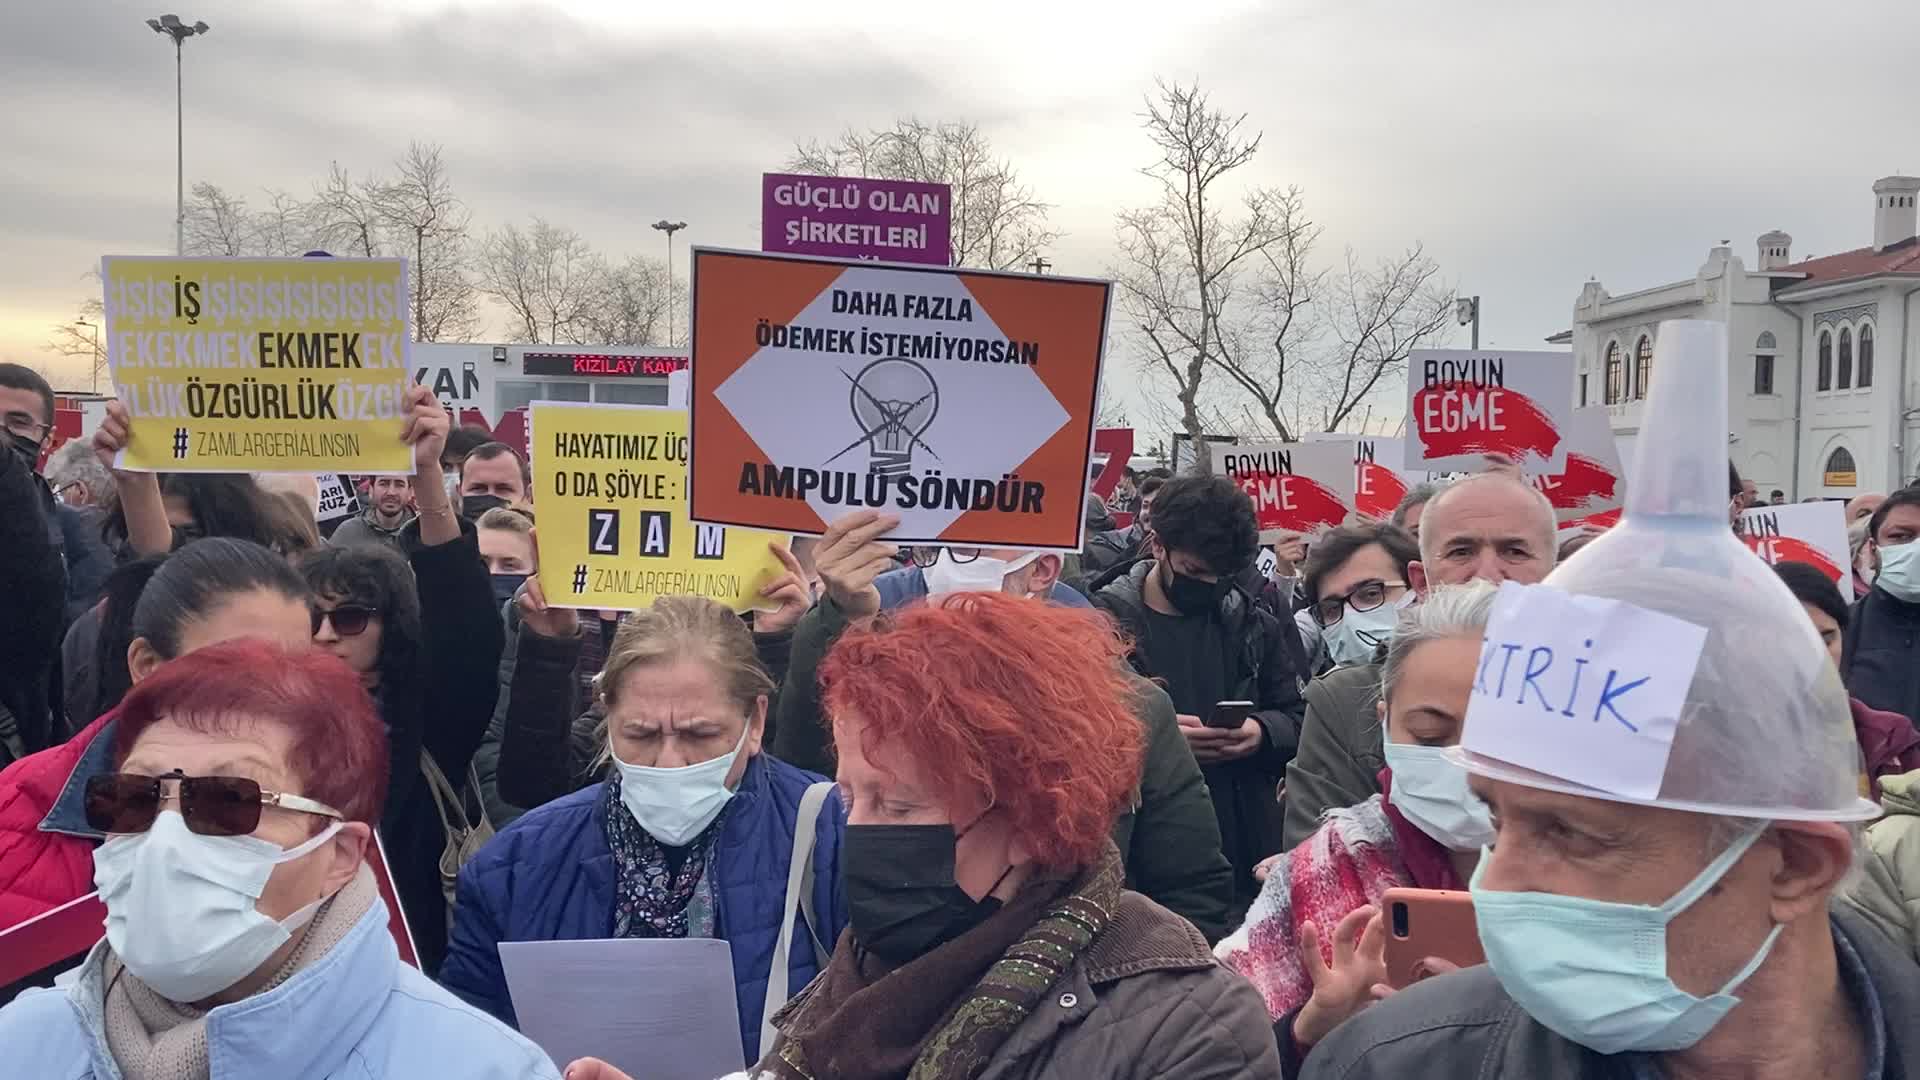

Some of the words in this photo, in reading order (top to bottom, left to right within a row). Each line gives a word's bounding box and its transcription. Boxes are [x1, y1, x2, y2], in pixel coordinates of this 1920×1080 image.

[774, 181, 860, 212] GÜÇLÜ
[868, 190, 939, 215] OLAN
[785, 216, 926, 249] ŞİRKETLERİ
[832, 289, 898, 318] DAHA
[903, 295, 973, 322] FAZLA
[259, 332, 362, 369] EKMEK
[755, 318, 855, 354] ÖDEMEK
[860, 326, 1039, 365] İSTEMİYORSAN
[574, 358, 637, 374] KIZILAY
[643, 361, 678, 374] KAN
[1424, 358, 1504, 391] BOYUN
[186, 376, 337, 420] ÖZGÜRLÜK
[1424, 390, 1506, 433] EĞME
[555, 432, 659, 461] HAYATIMIZ
[1225, 450, 1293, 480] BOYUN
[555, 471, 567, 497] O
[573, 471, 600, 498] DA
[895, 470, 1046, 514] SÖNDÜR
